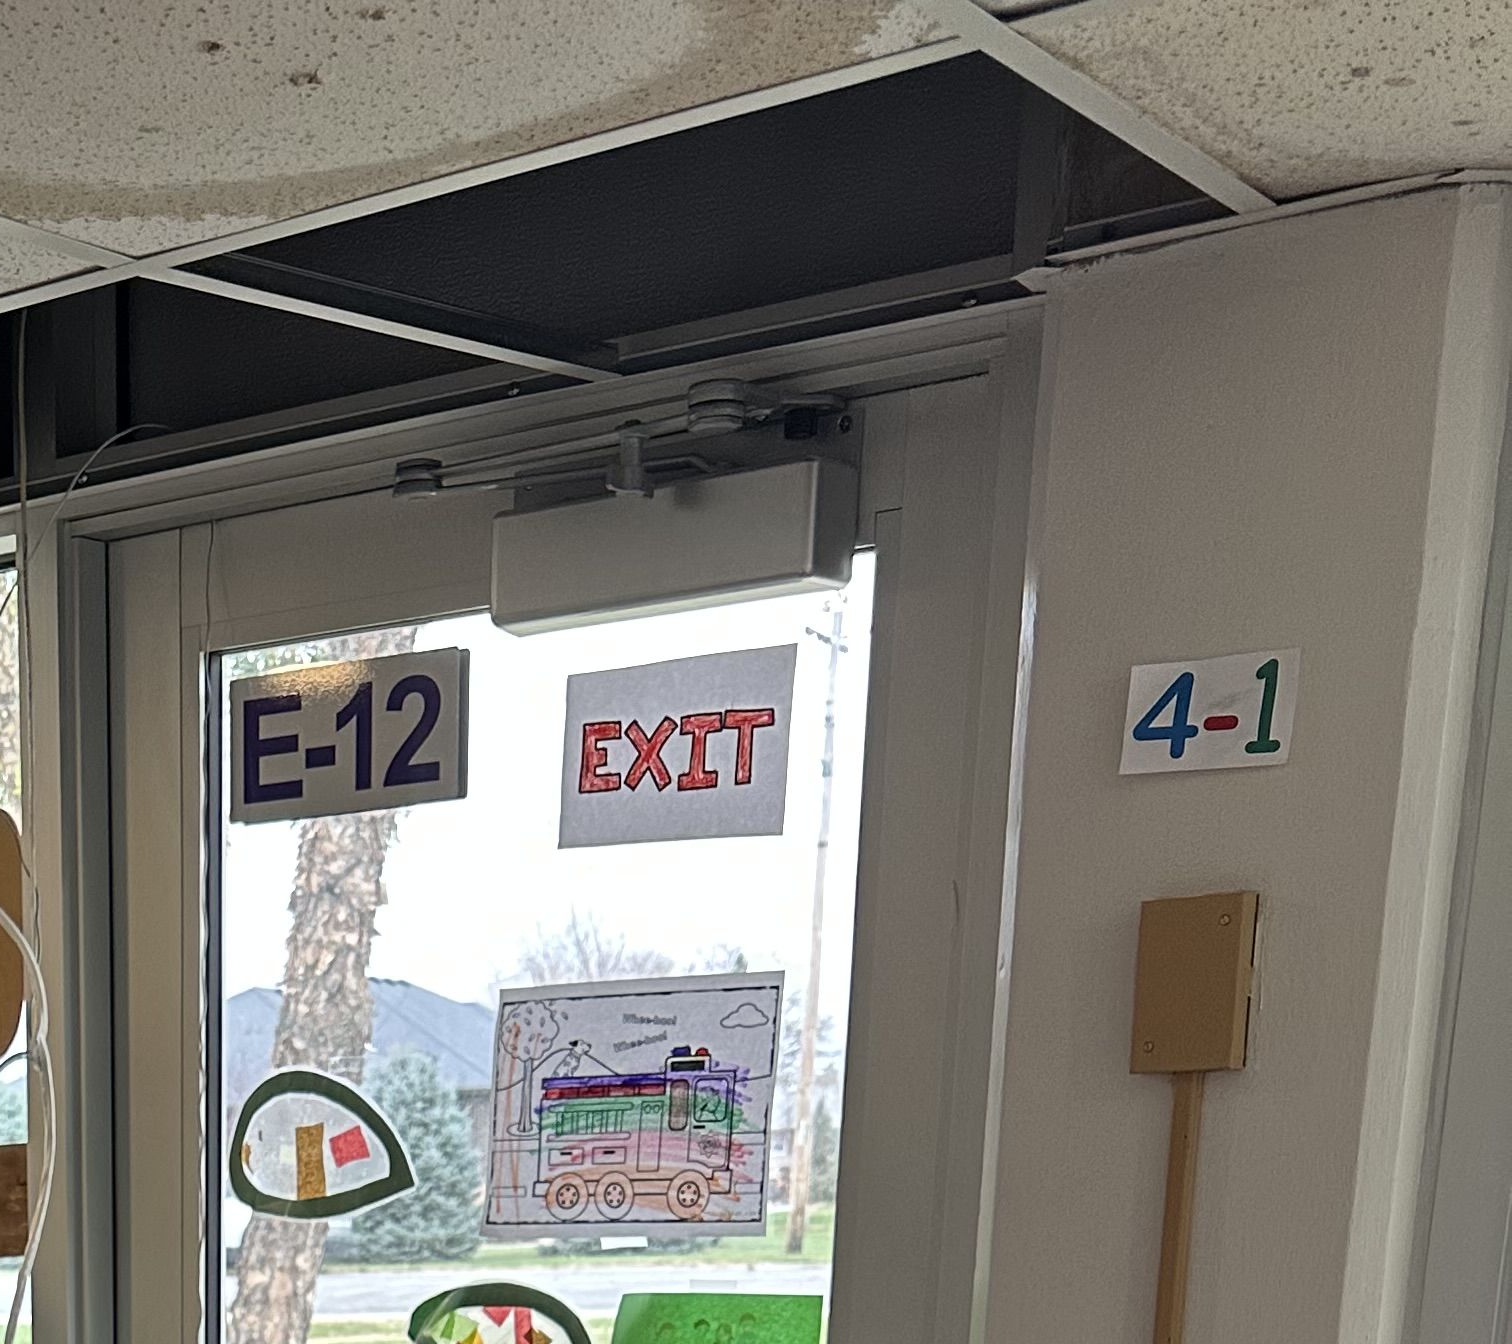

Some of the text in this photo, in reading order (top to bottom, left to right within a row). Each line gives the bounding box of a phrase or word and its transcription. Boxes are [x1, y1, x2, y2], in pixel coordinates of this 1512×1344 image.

[241, 674, 443, 804] E-12
[578, 708, 775, 794] EXIT
[1131, 658, 1281, 760] 4-1
